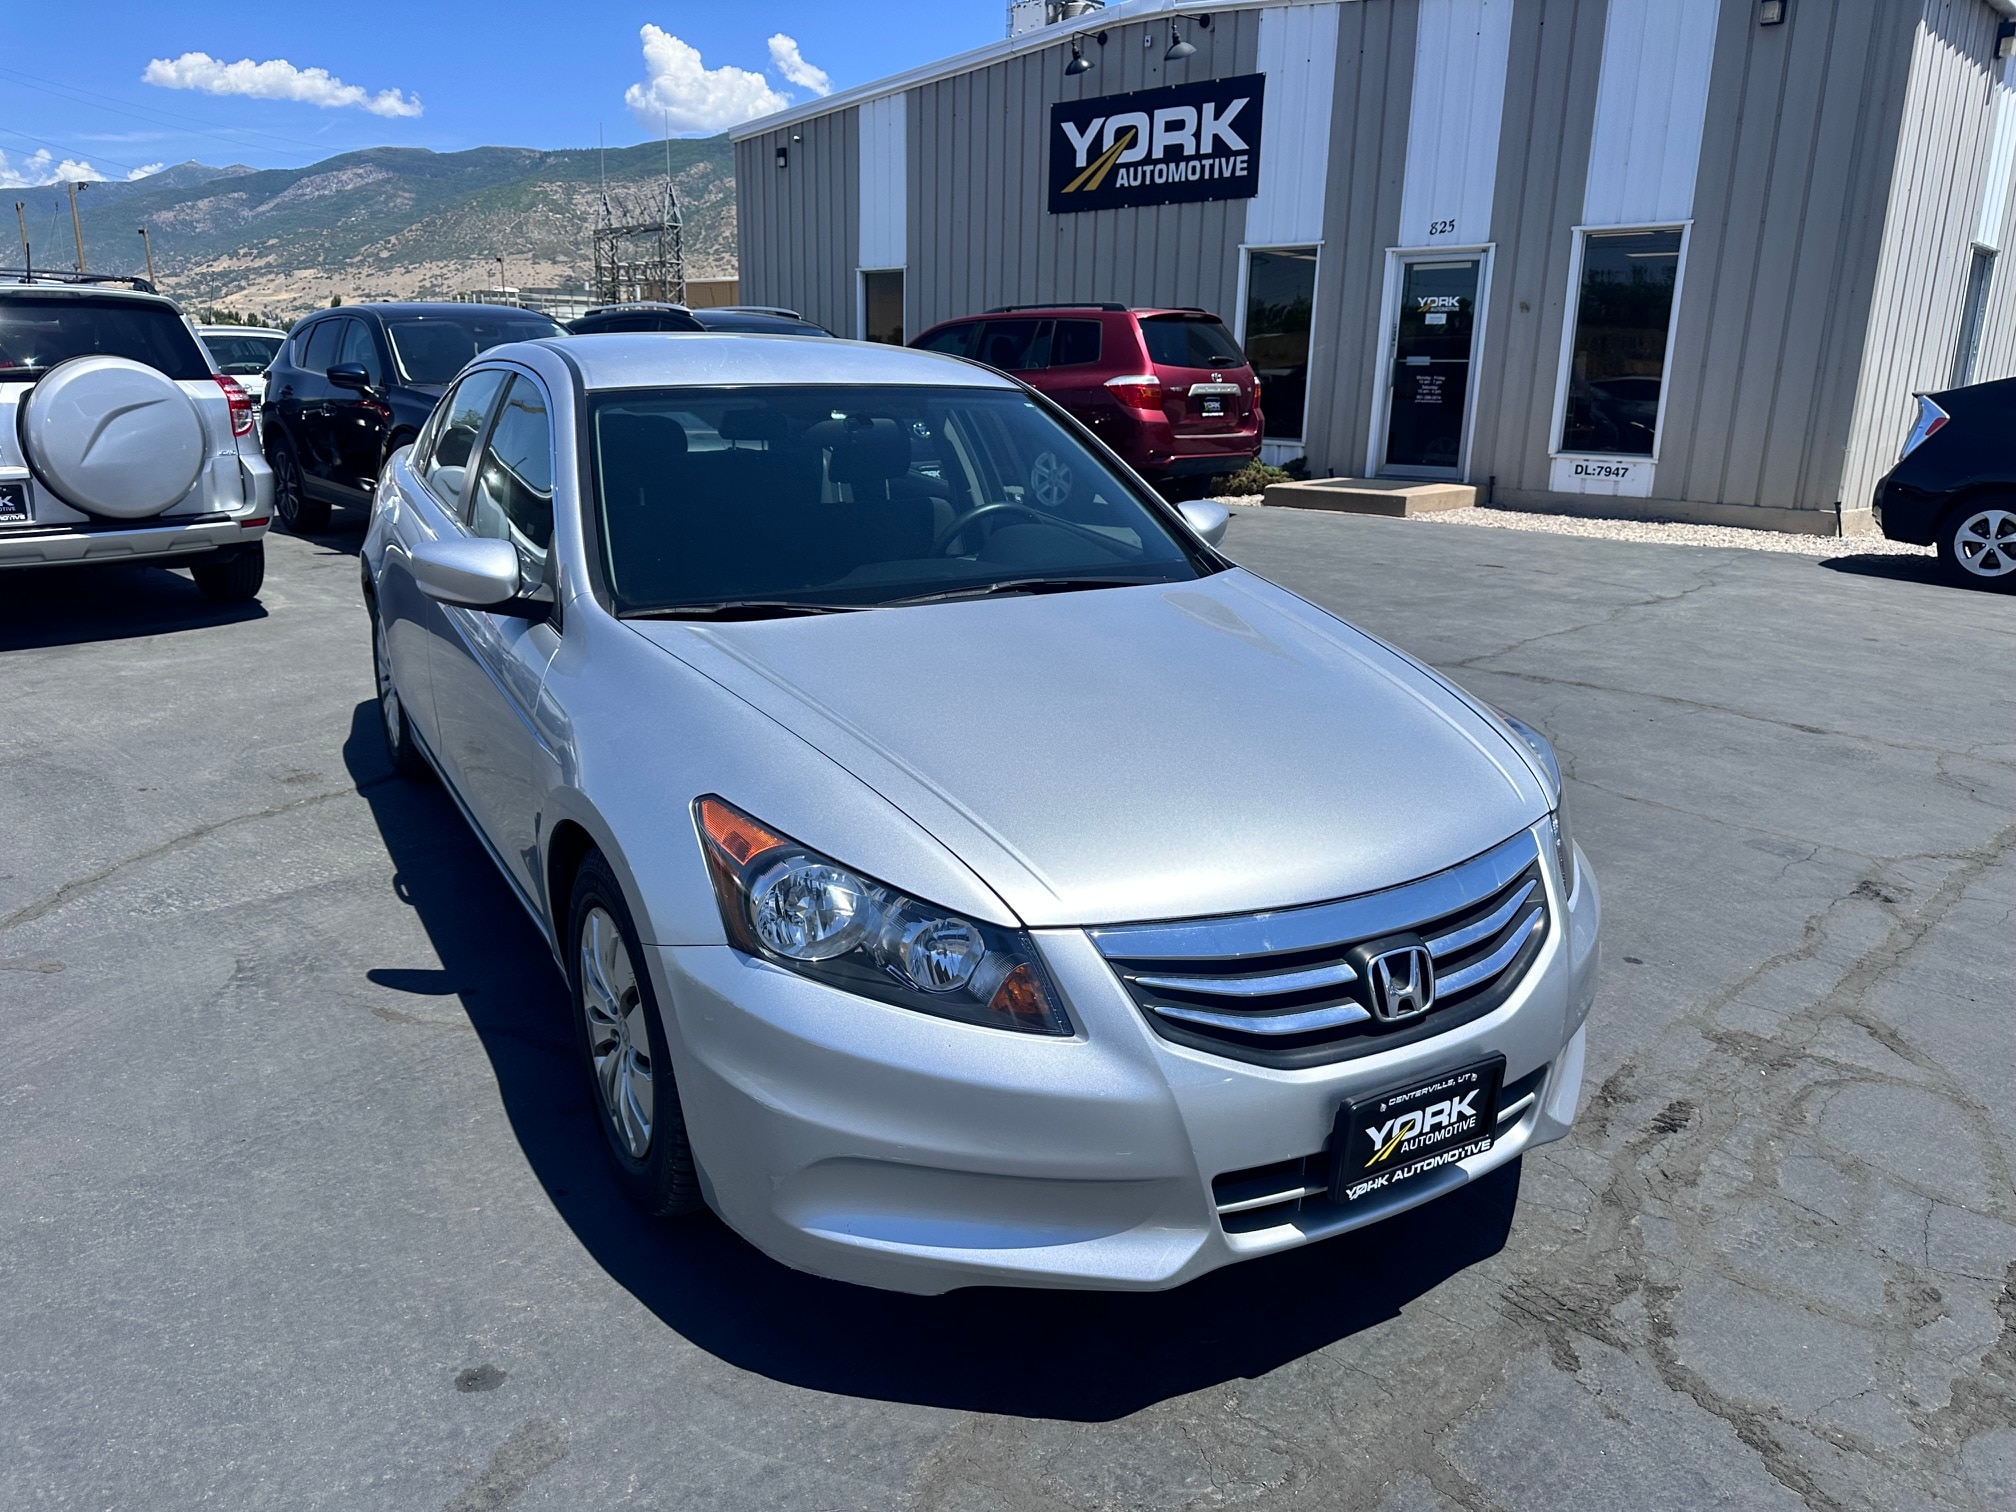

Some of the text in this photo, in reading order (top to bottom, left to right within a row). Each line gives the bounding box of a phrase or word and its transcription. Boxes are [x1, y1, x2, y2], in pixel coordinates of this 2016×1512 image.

[1060, 97, 1250, 168] YORK
[1115, 155, 1249, 188] AUTOMOTIVE
[1429, 218, 1456, 235] 825
[1417, 296, 1460, 307] YORK
[1574, 464, 1629, 478] DL:7947
[1388, 1073, 1471, 1106] CENTERVILLE, UT
[1365, 1088, 1480, 1151] YORK
[1400, 1116, 1477, 1154] AUTOMOTIVE
[1391, 1138, 1492, 1183] AUTOMOTIVE
